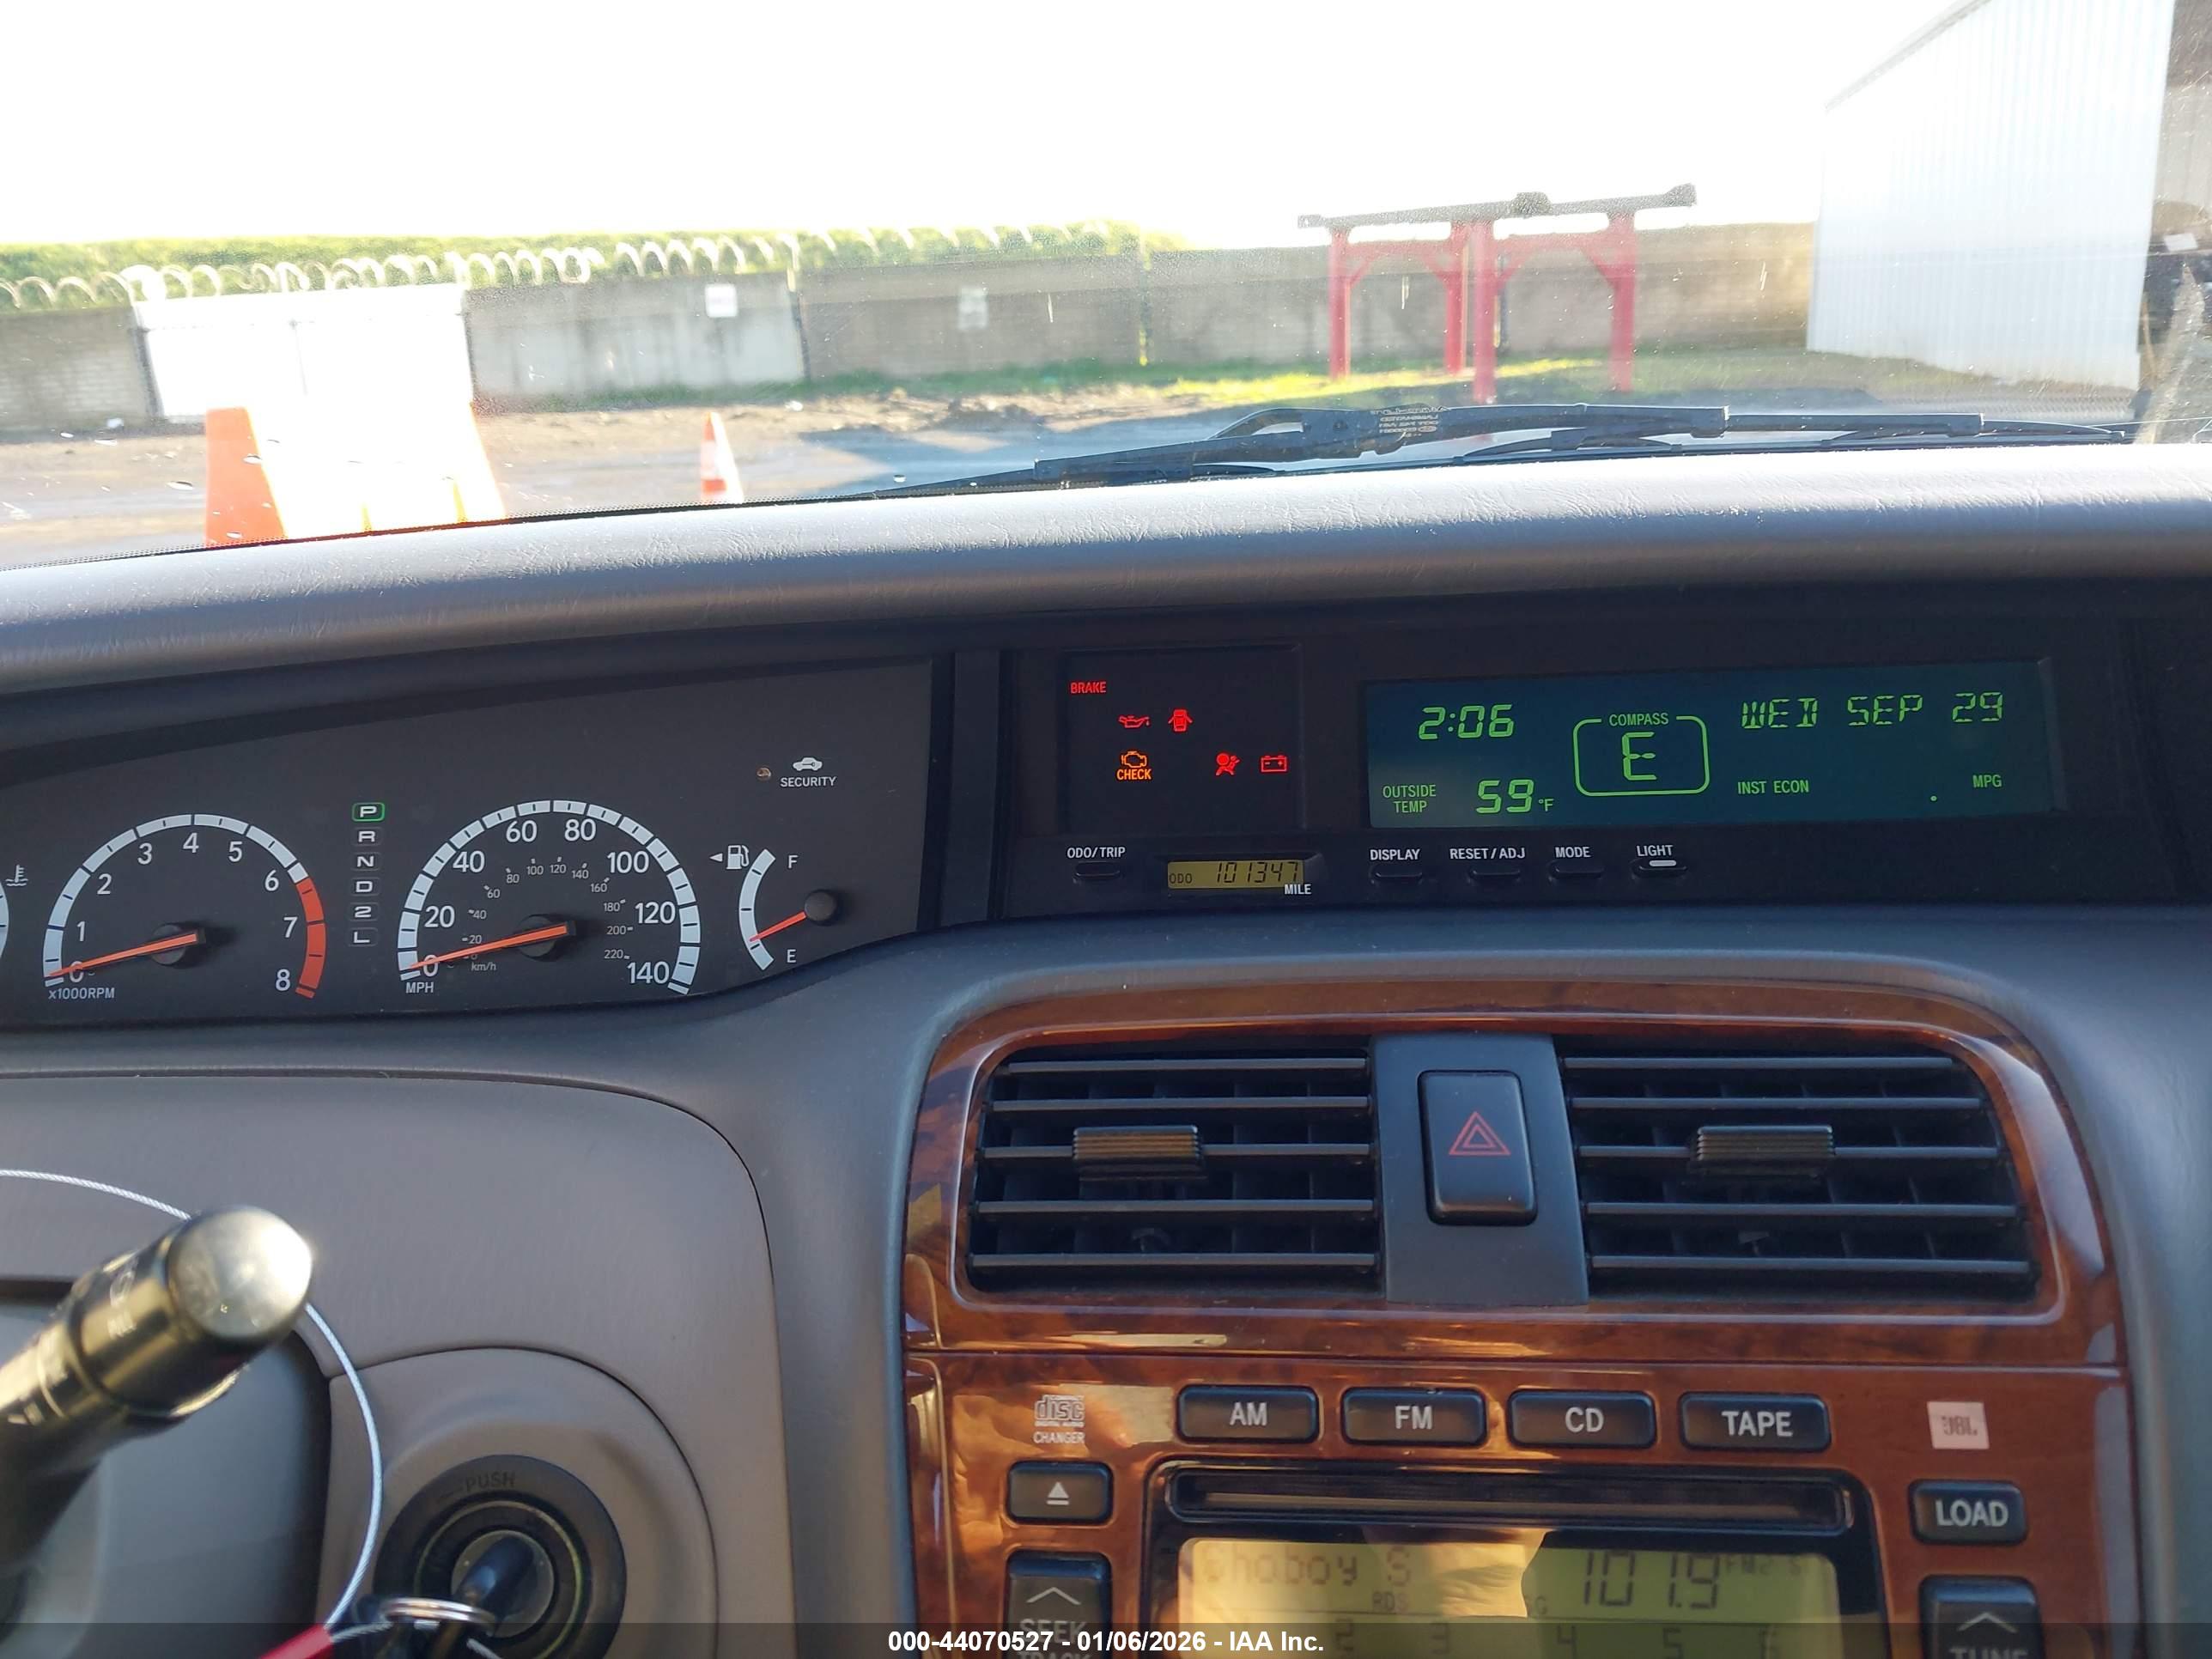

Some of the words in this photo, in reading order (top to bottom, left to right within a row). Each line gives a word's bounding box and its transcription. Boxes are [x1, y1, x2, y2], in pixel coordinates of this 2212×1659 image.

[1070, 681, 1107, 695] BRAKE
[1741, 696, 1820, 729] WED
[1847, 694, 1923, 726] SEP
[1951, 691, 2004, 723] 29
[1418, 703, 1516, 740] 2:06
[1608, 712, 1669, 727] COMPASS
[1621, 731, 1657, 781] E
[780, 775, 837, 788] SECURITY
[1116, 768, 1152, 781] CHECK
[1737, 781, 1767, 795] INST
[1773, 780, 1810, 794] ECON
[1972, 775, 2002, 789] MPG
[1382, 784, 1437, 799] OUTSIDE
[1475, 778, 1535, 814] 59
[359, 805, 378, 818] P
[1394, 799, 1428, 814] TEMP
[357, 830, 376, 843] R
[505, 820, 538, 843] 60
[563, 819, 597, 842] 80
[182, 832, 200, 854] 4
[137, 843, 153, 866] 3
[228, 841, 244, 862] 5
[1066, 846, 1126, 859] ODO/TRIP
[1370, 848, 1420, 861] DISPLAY
[1555, 846, 1591, 860] MODE
[1636, 844, 1674, 858] LIGHT
[356, 855, 374, 867] N
[453, 850, 486, 873] 40
[606, 851, 650, 874] 100
[787, 855, 798, 869] F
[526, 866, 544, 876] 100
[549, 864, 567, 874] 120
[571, 869, 589, 879] 140
[1216, 861, 1299, 884] 101347
[96, 874, 112, 896] 2
[264, 869, 280, 891] 6
[506, 873, 520, 884] 80
[1169, 872, 1193, 884] ODO
[355, 880, 374, 893] D
[487, 888, 501, 899] 60
[590, 883, 608, 893] 160
[1284, 883, 1312, 895] MILE
[354, 905, 372, 918] 2
[603, 902, 621, 912] 180
[634, 902, 677, 925] 120
[424, 905, 455, 928] 20
[472, 909, 487, 920] 40
[76, 921, 86, 942] 1
[283, 916, 298, 938] 7
[606, 925, 627, 935] 200
[353, 931, 370, 944] L
[468, 934, 483, 945] 20
[604, 949, 623, 959] 220
[787, 950, 797, 963] E
[69, 960, 84, 983] 0
[422, 954, 440, 977] 0
[471, 962, 497, 972] km/h
[626, 961, 671, 985] 140
[275, 969, 291, 992] 8
[405, 981, 434, 994] MPH
[1229, 1401, 1268, 1426] AM
[1395, 1405, 1433, 1431] FM
[1564, 1406, 1604, 1434] CD
[1721, 1410, 1794, 1437] TAPE
[1033, 1431, 1086, 1444] CHANGER
[465, 1470, 517, 1492] PUSH
[1935, 1499, 2009, 1528] LOAD
